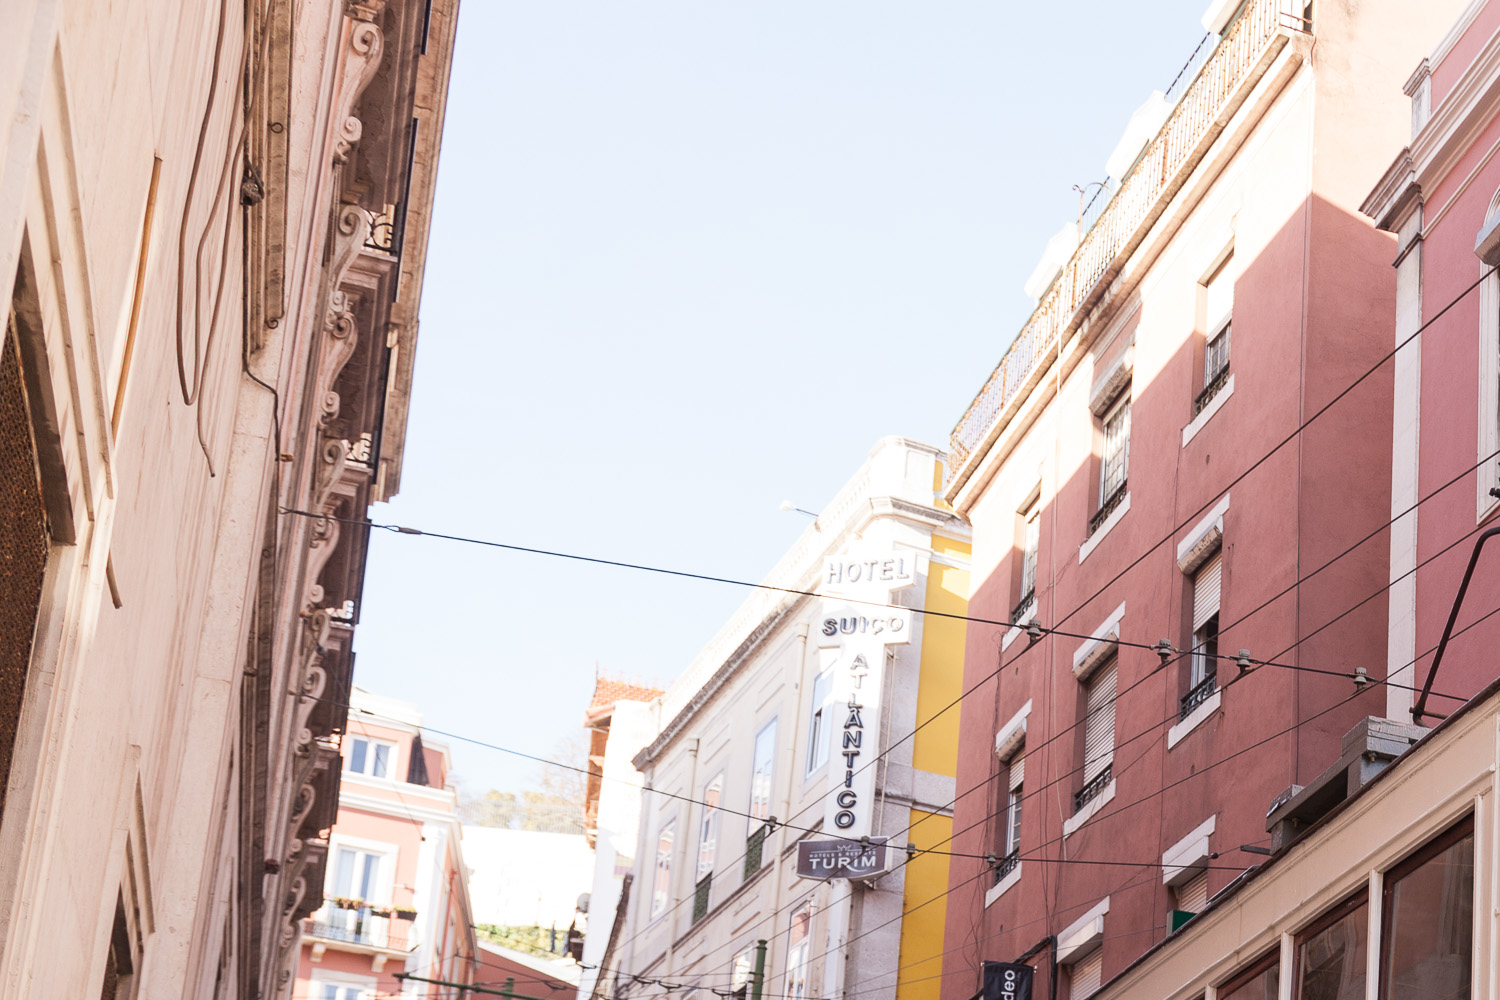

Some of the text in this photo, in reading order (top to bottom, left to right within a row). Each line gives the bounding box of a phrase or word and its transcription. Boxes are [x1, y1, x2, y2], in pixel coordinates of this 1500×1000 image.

[826, 558, 909, 585] HOTEL
[822, 616, 904, 636] SUIÇO
[808, 856, 877, 871] TURIM
